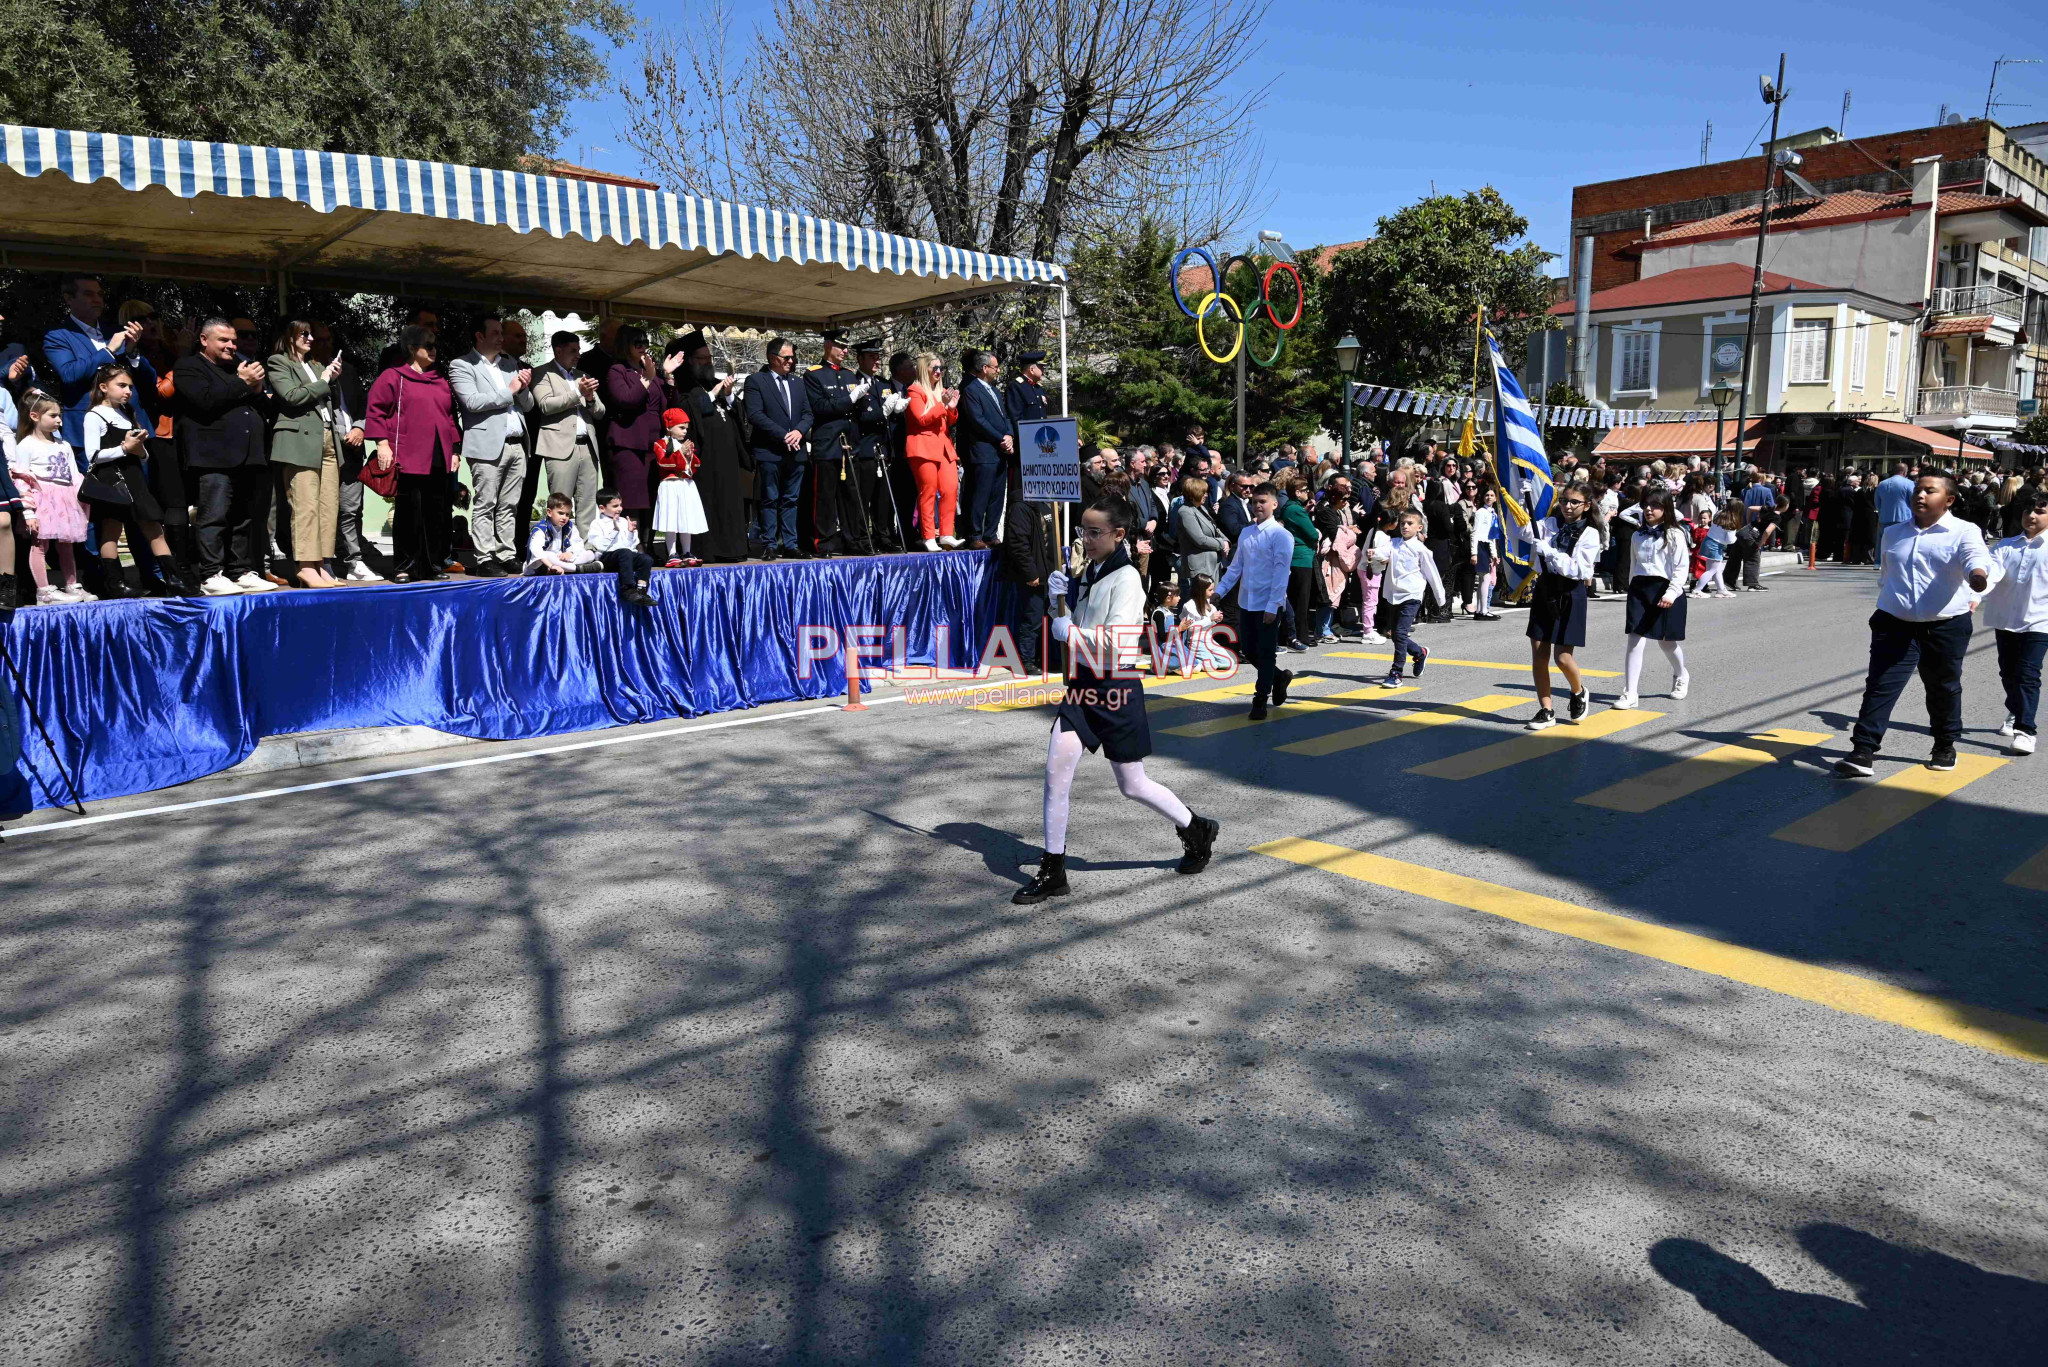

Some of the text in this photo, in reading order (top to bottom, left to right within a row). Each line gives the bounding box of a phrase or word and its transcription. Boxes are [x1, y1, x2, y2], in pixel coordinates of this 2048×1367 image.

[1022, 463, 1079, 477] ΔΗΜΟΤΙΚΟ ΣΧΟΛΕΙΟ
[1023, 480, 1080, 496] ΛΟΥΤΡΟΧΩΡΙΟΥ
